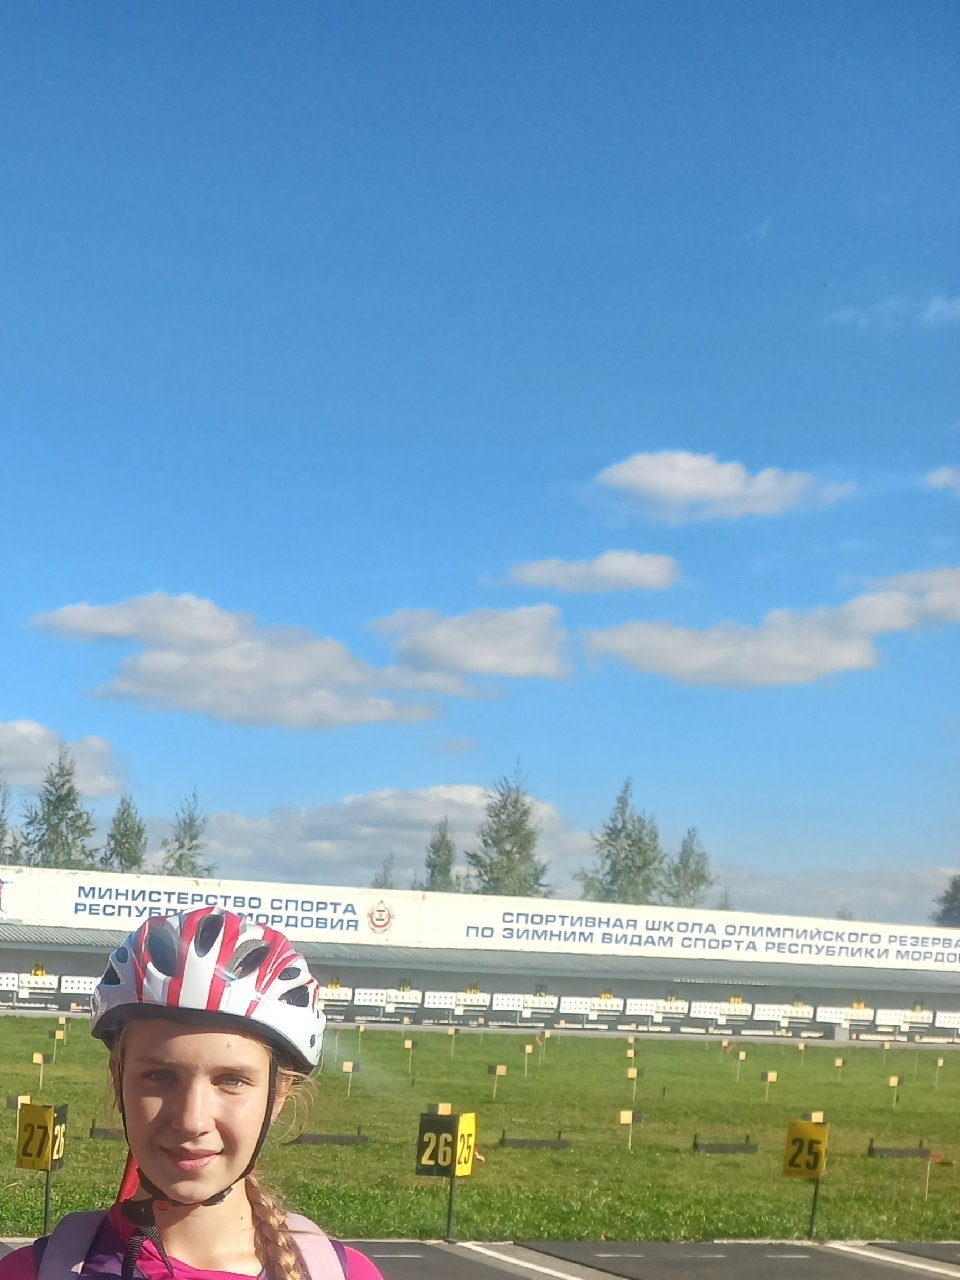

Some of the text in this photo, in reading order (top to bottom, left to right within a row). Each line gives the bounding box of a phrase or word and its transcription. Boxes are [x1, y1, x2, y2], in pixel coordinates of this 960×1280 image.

[74, 902, 183, 917] РЕСПУБЛ
[78, 886, 357, 915] МИНИСТЕРСТВО СПОРТА
[502, 912, 638, 930] СПОРТИВНАЯ
[645, 920, 716, 935] ШКОЛА
[724, 924, 881, 944] ОЛИМПИЙСКОГО
[466, 926, 960, 963] ПО ЗИМНИМ ВИДАМ СПОРТА РЕСПУБЛИКИ МОРДО
[22, 1123, 48, 1158] 27
[421, 1132, 452, 1166] 26
[458, 1133, 472, 1165] 25
[788, 1137, 822, 1170] 25
